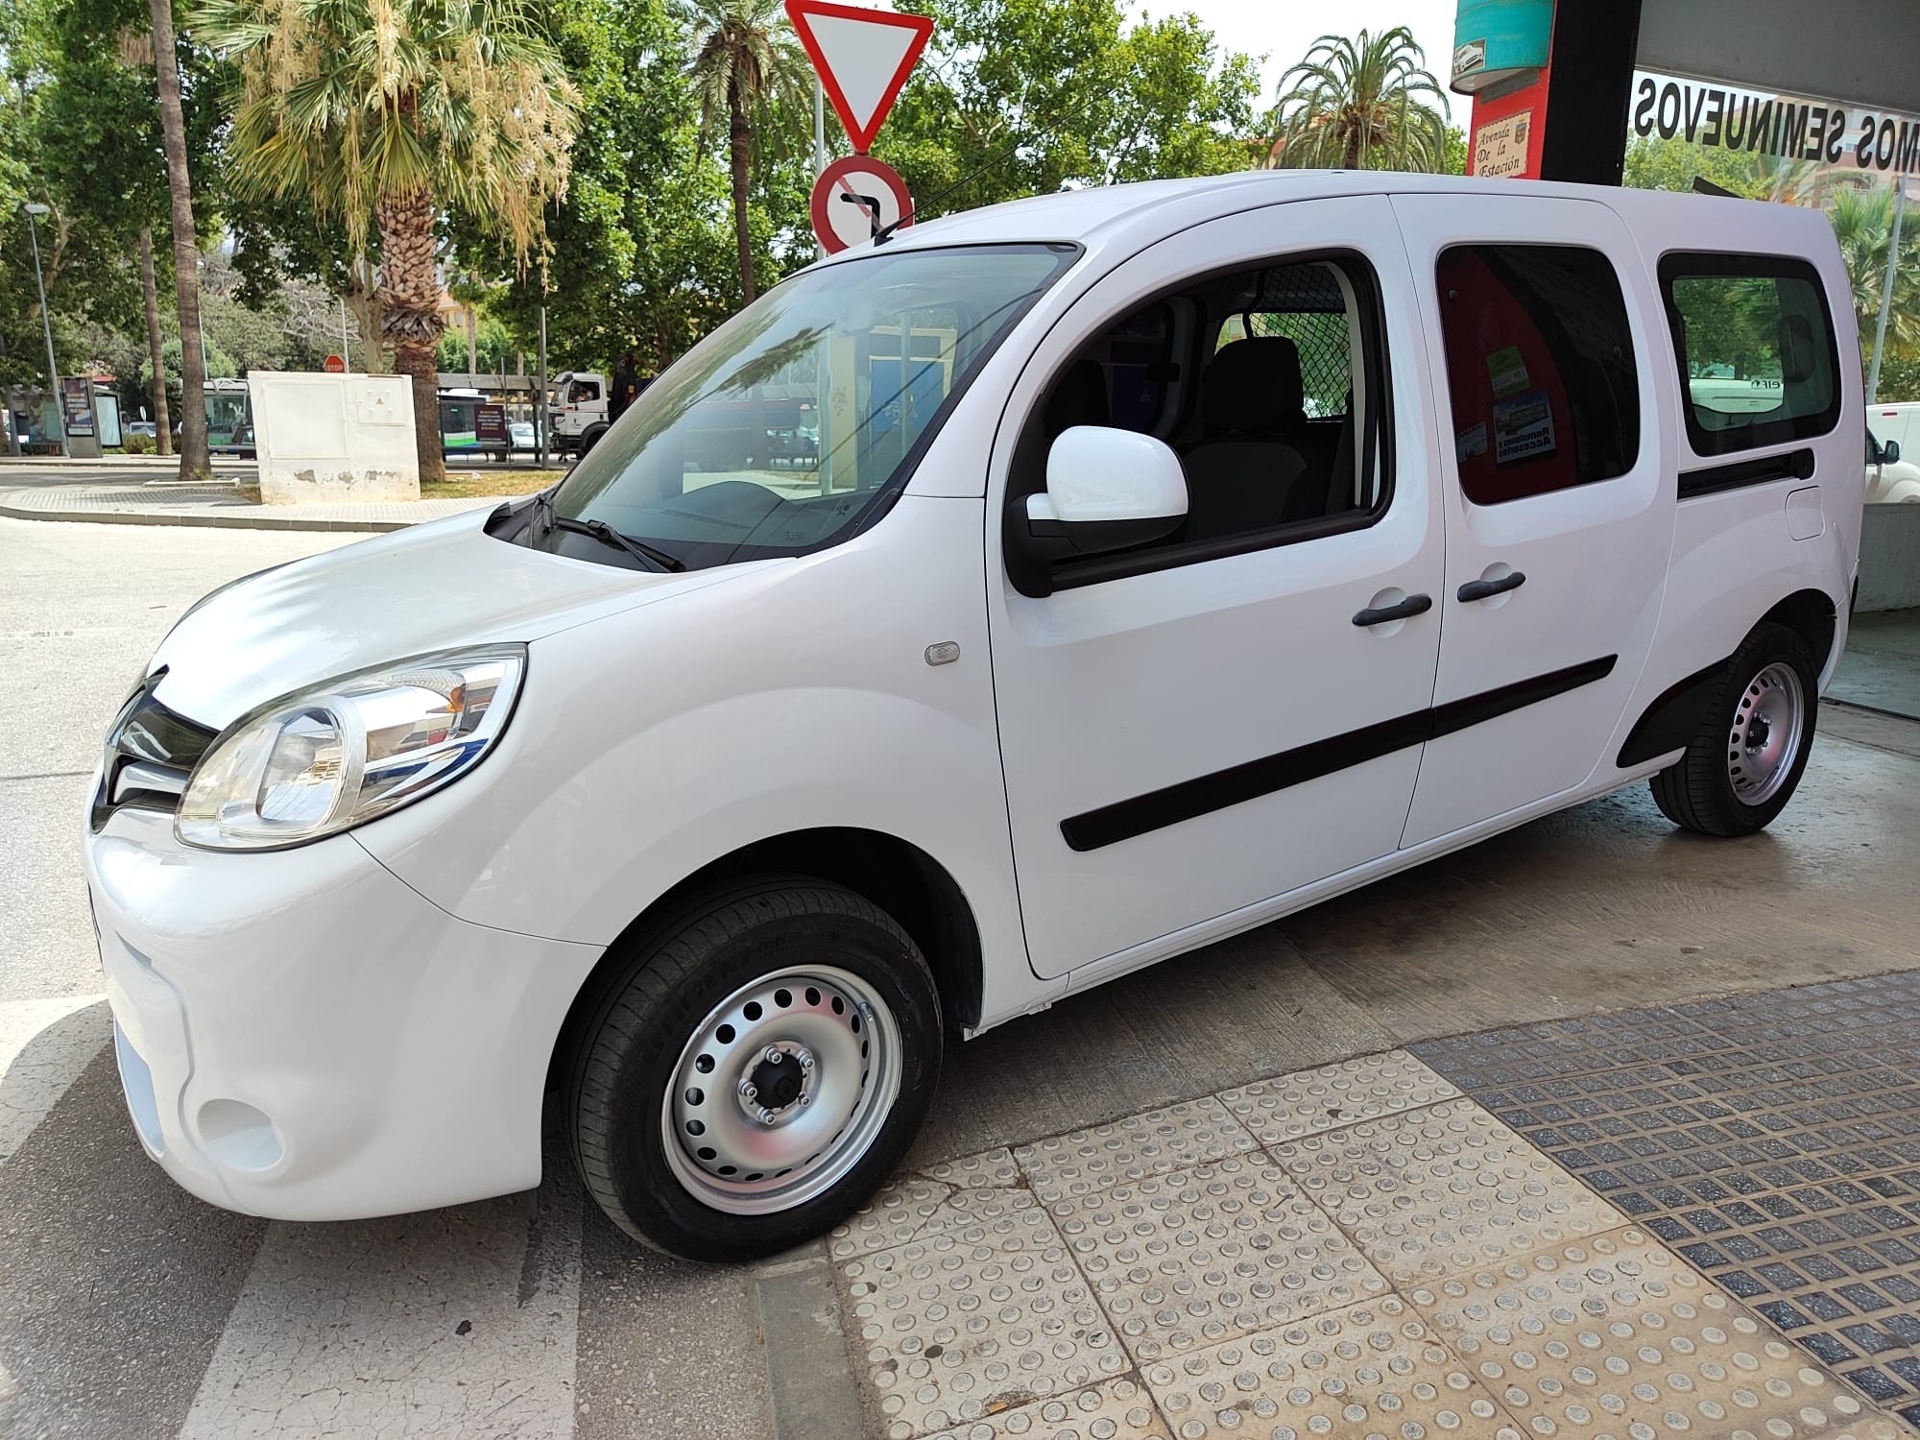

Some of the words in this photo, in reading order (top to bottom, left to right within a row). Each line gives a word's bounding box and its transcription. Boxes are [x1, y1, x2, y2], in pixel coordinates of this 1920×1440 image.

[1478, 123, 1510, 148] Avenida
[1477, 149, 1491, 163] De
[1497, 139, 1506, 156] la
[1479, 154, 1520, 177] Estación
[327, 364, 344, 372] STOP
